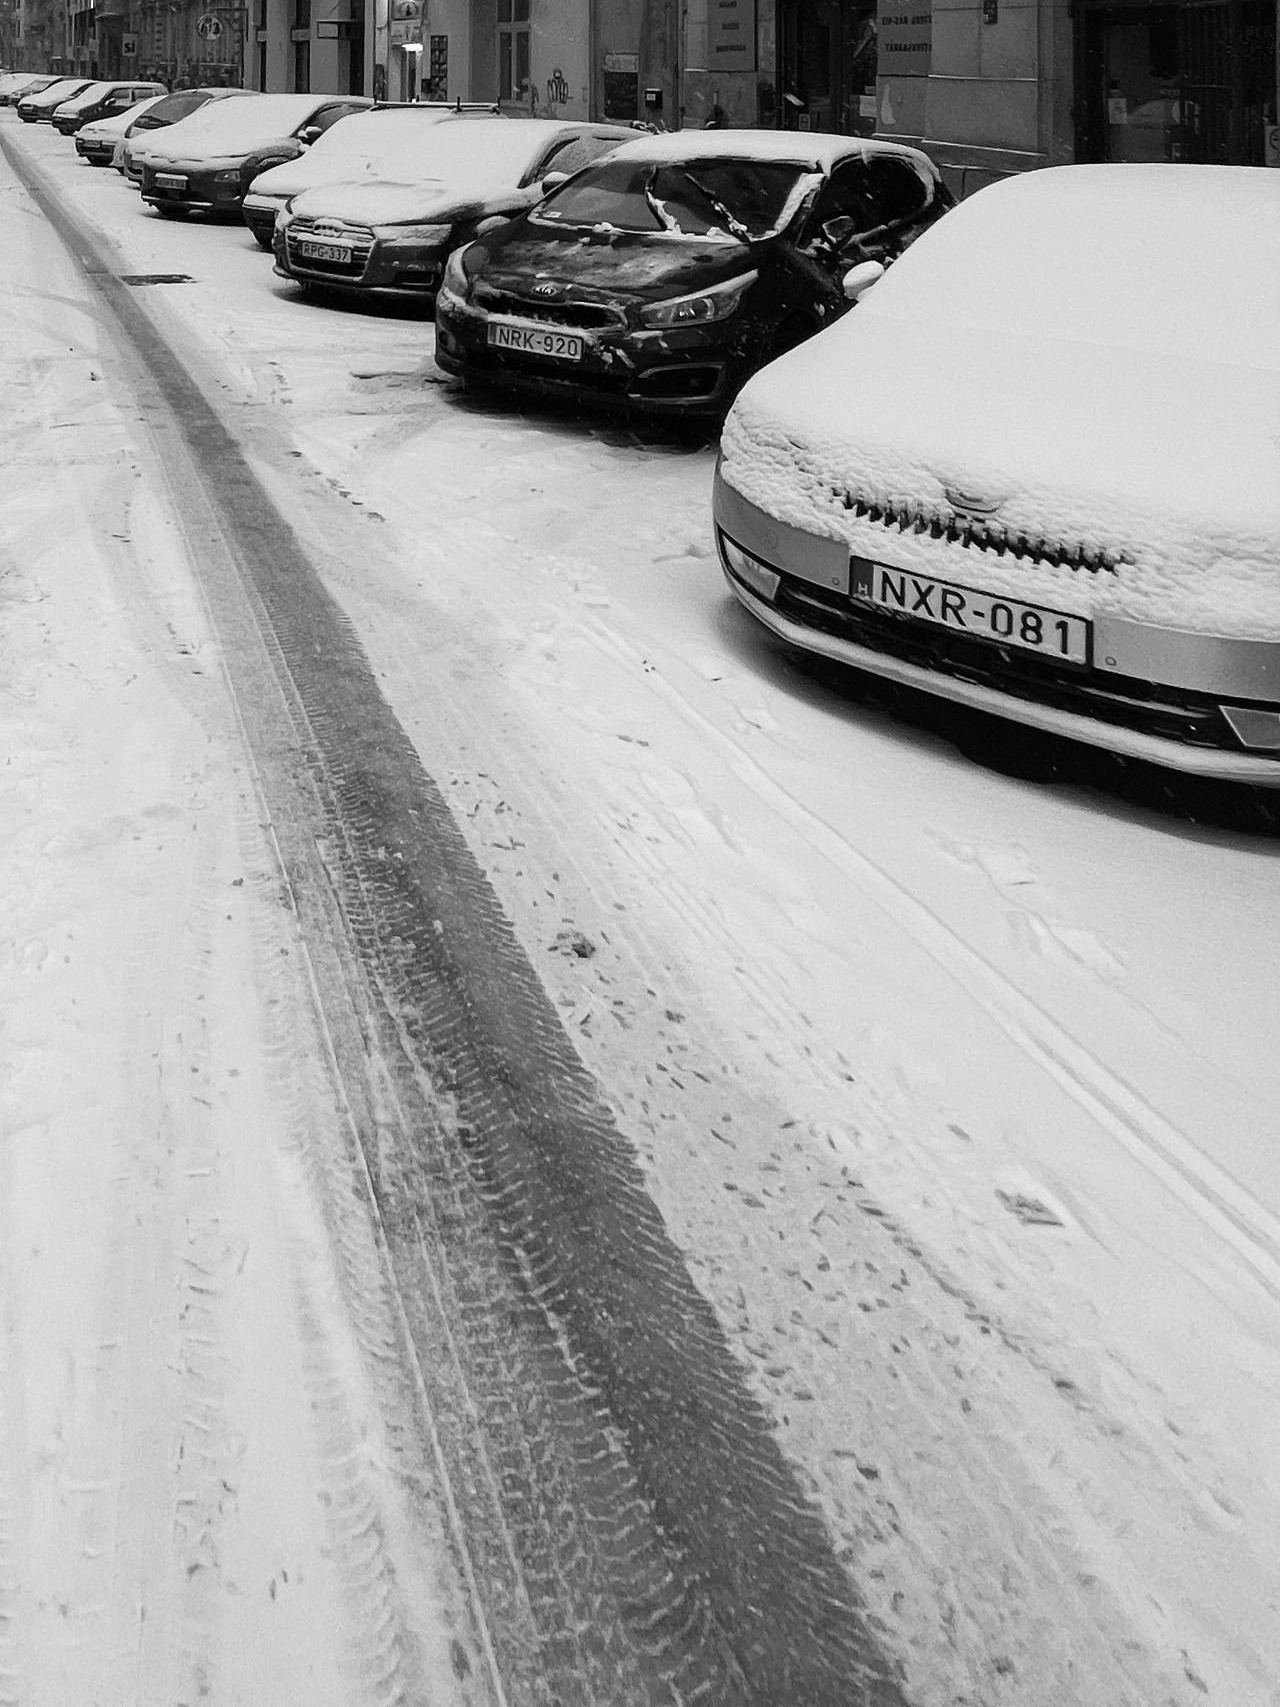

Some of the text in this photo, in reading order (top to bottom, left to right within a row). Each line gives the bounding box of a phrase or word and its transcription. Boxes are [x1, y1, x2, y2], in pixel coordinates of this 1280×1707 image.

[303, 243, 348, 261] RPG-337
[499, 328, 578, 356] NRK-920
[881, 570, 1069, 655] NXR-081
